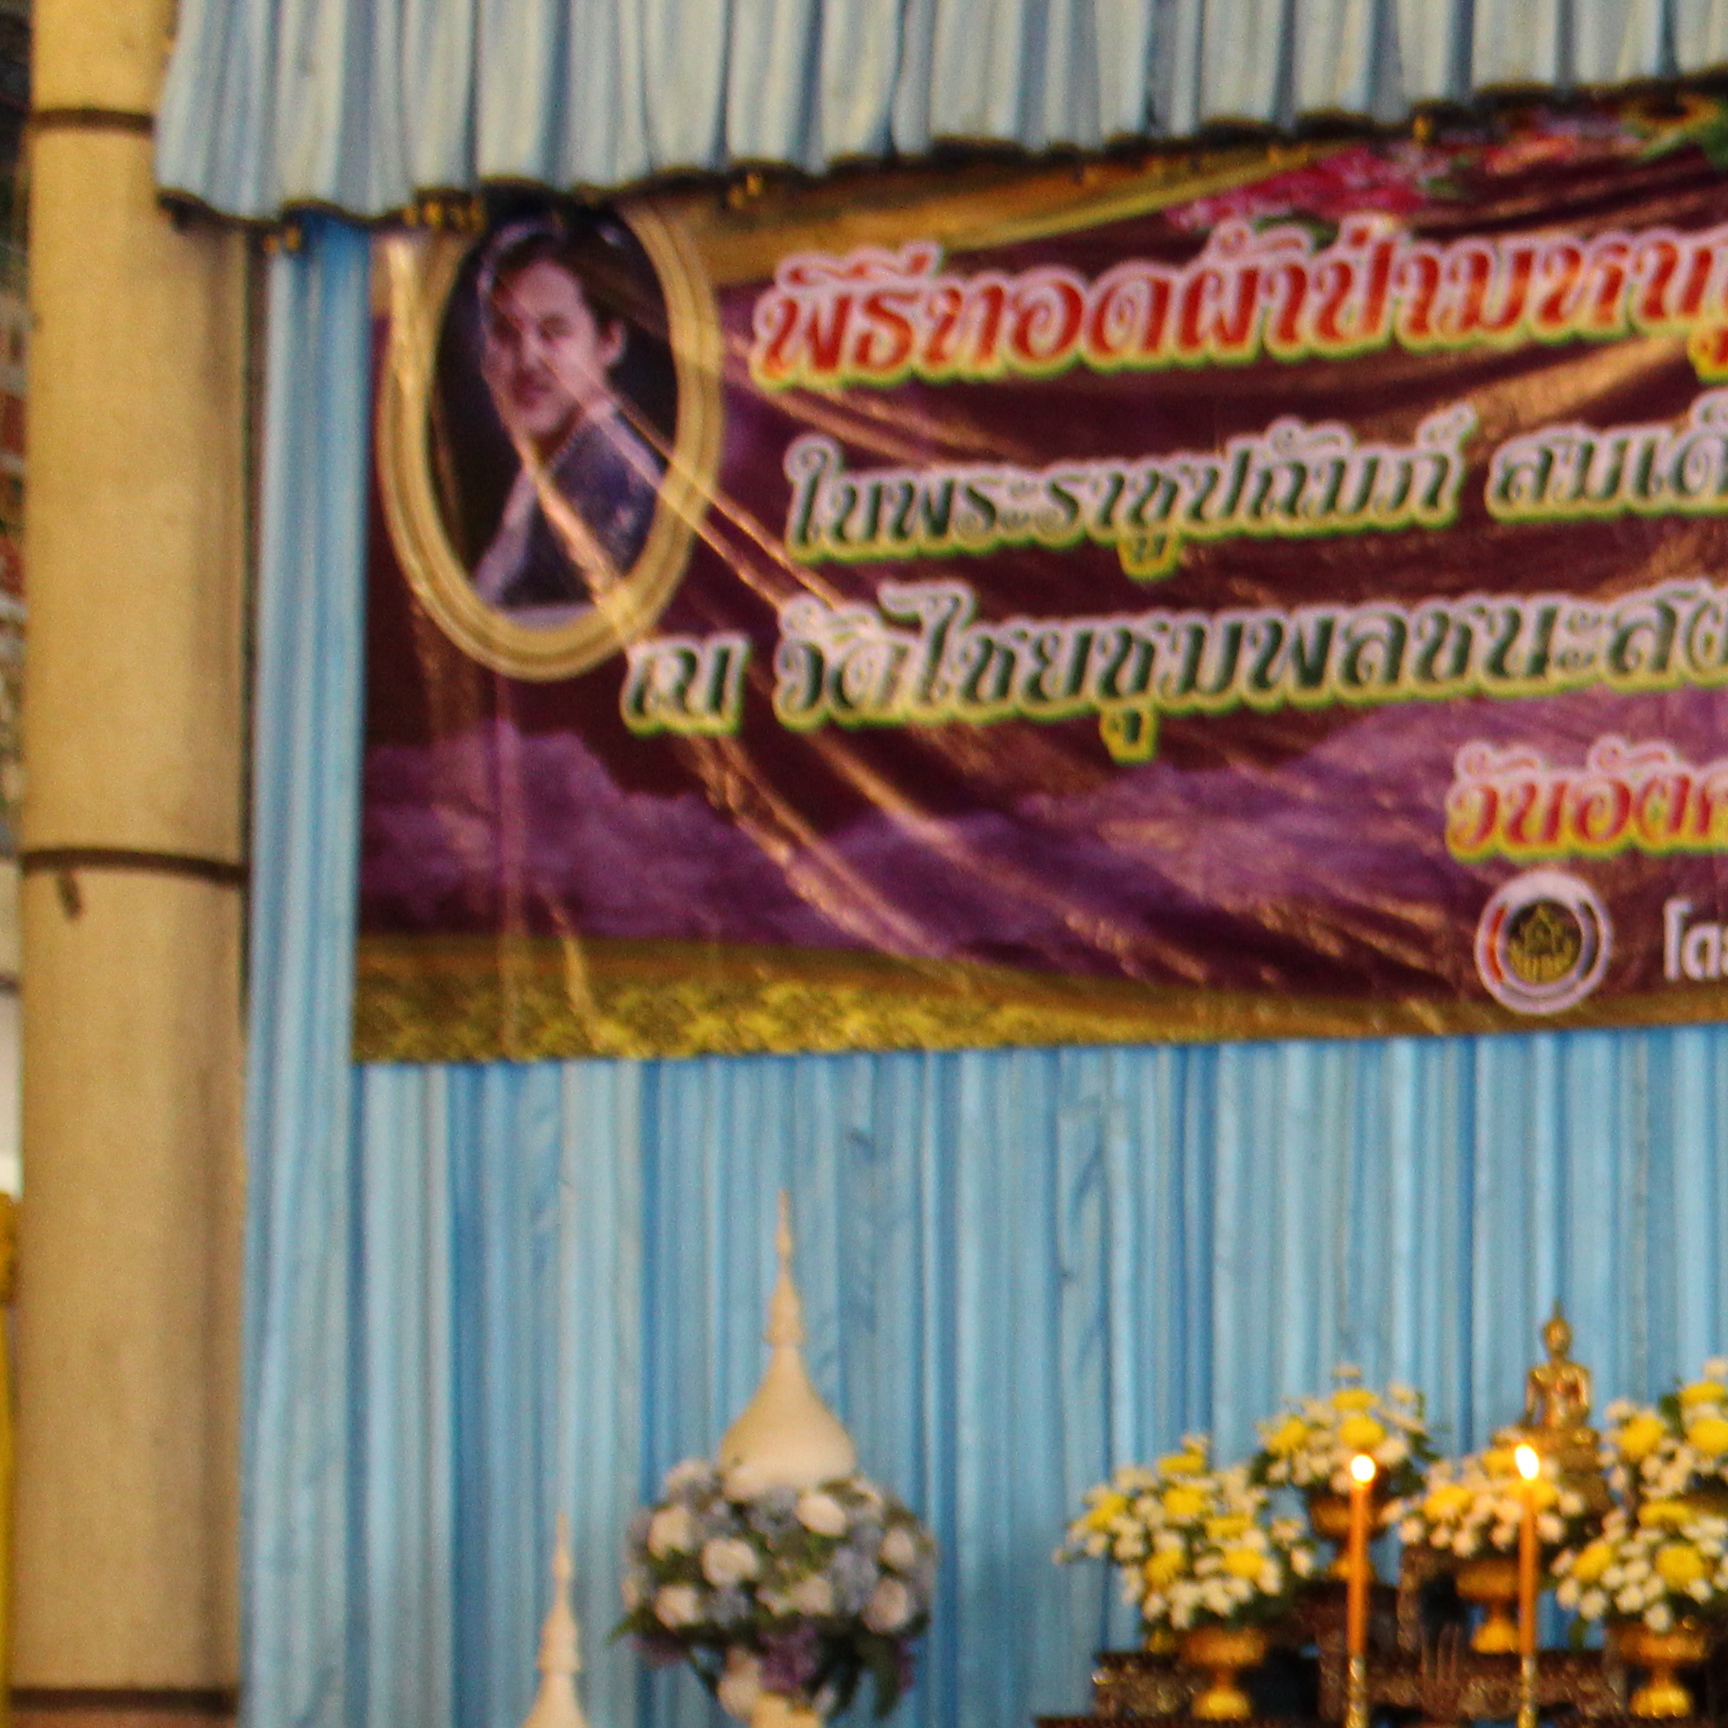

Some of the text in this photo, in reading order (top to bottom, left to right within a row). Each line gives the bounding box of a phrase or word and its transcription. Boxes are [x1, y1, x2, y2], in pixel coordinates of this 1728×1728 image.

[785, 408, 1476, 576] ในพระราชูปถัมภ์
[621, 634, 748, 732] ณ
